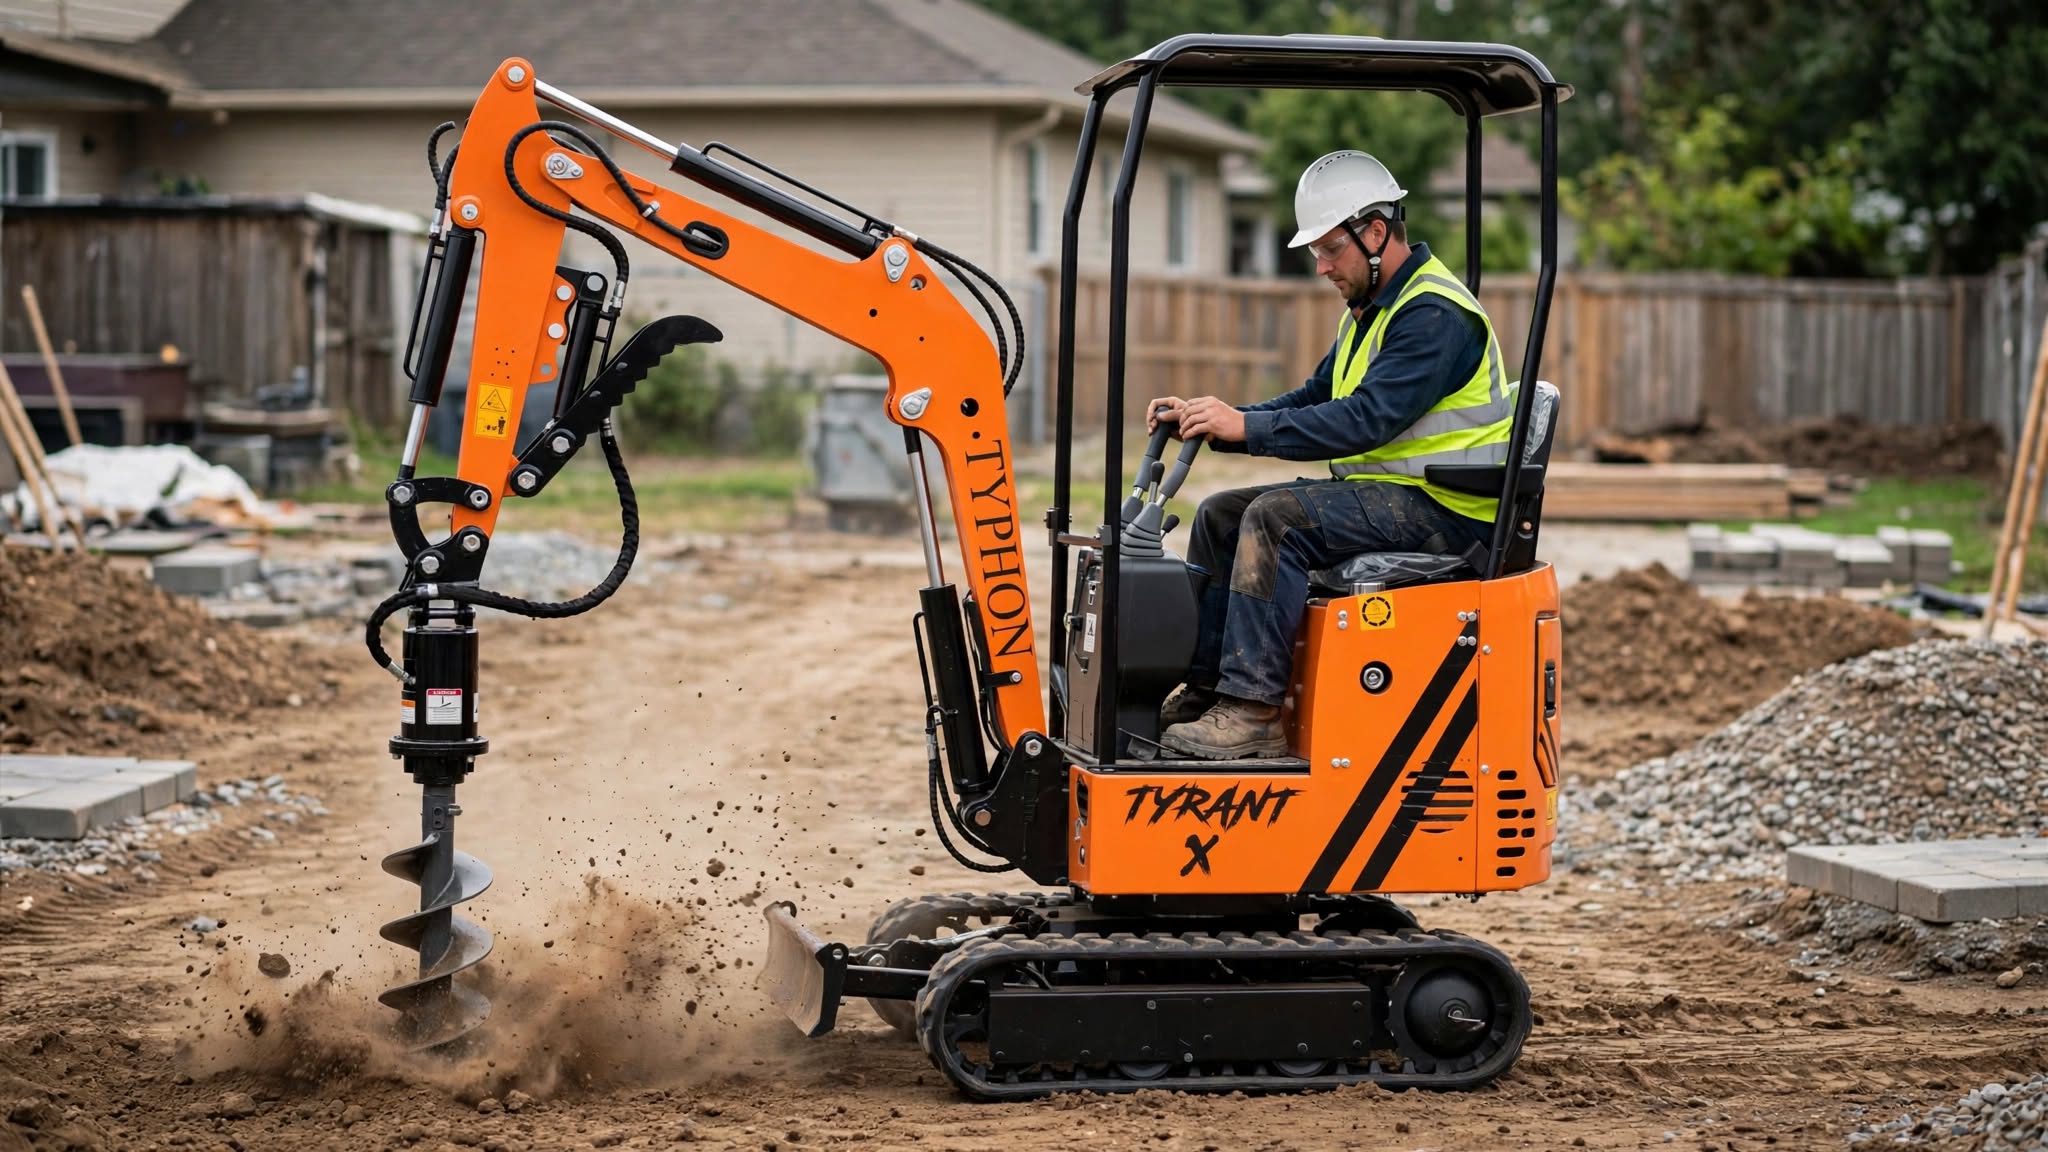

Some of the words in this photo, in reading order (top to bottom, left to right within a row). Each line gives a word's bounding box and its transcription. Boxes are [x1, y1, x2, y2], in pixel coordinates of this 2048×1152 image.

[965, 439, 1033, 657] TYPHON
[1124, 781, 1306, 832] TYRANT
[1180, 834, 1219, 877] X
